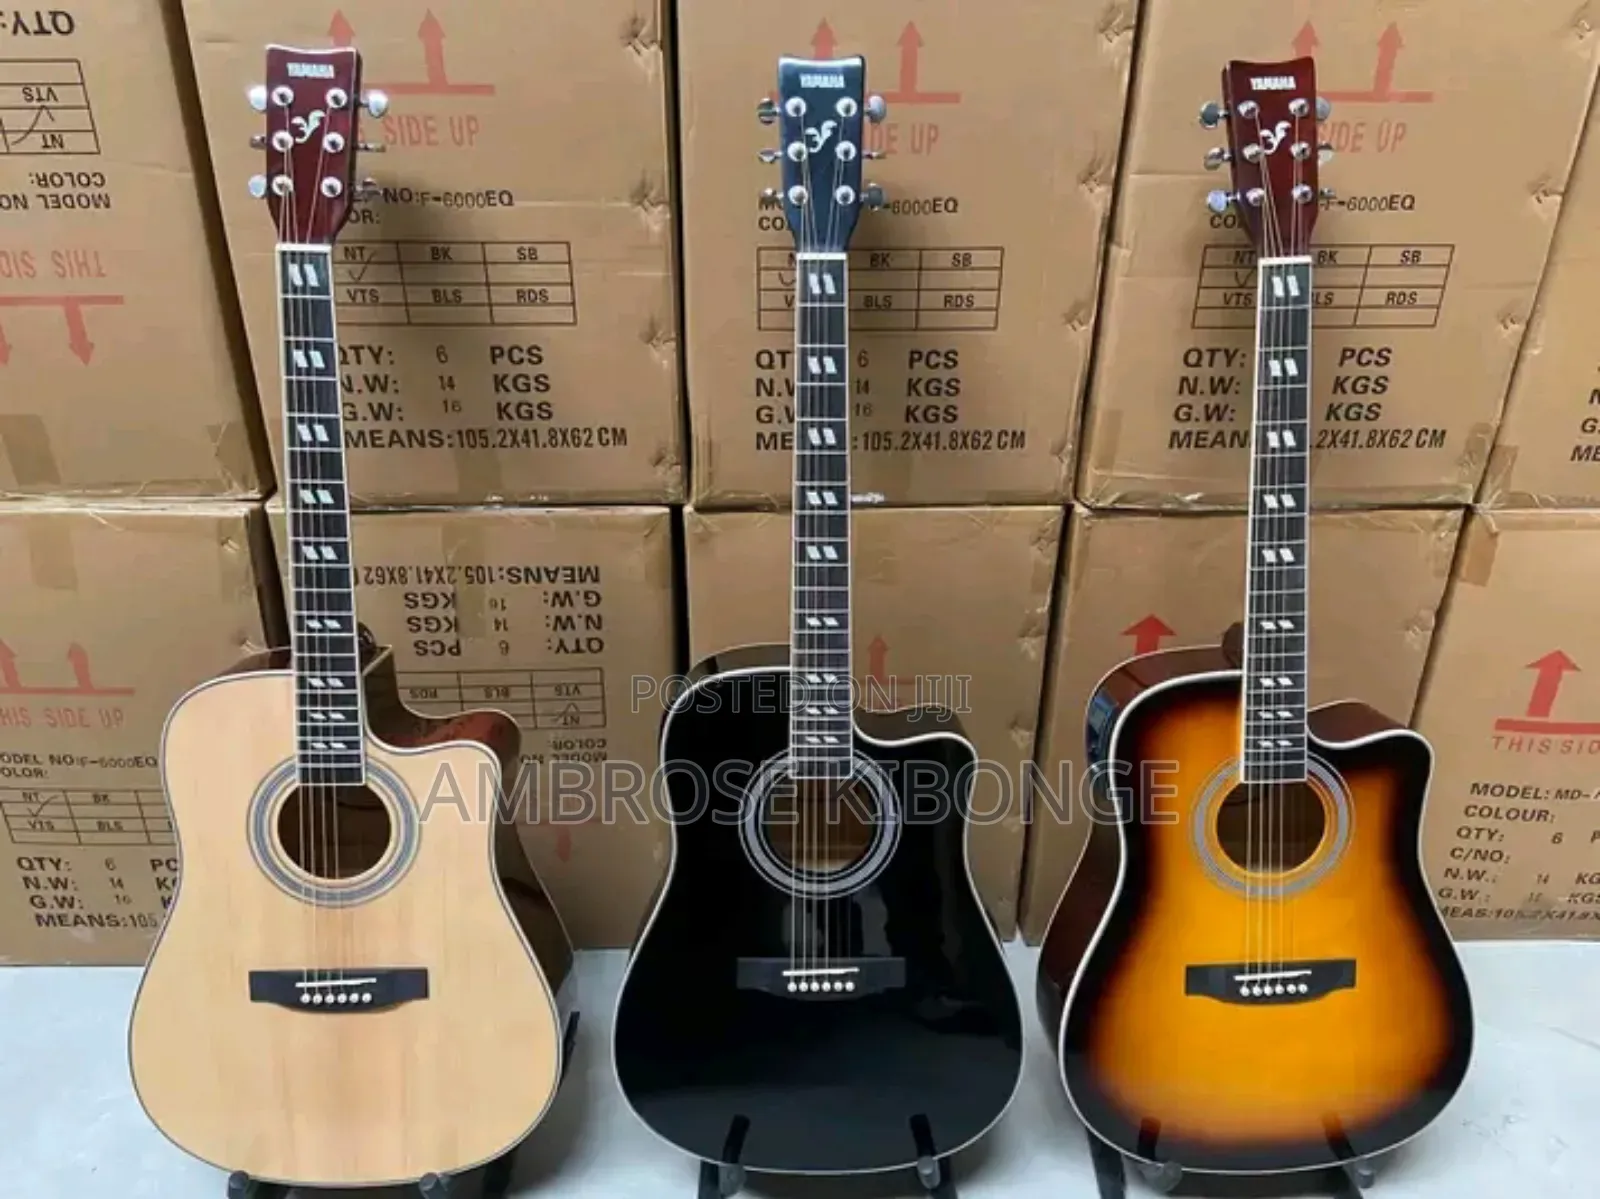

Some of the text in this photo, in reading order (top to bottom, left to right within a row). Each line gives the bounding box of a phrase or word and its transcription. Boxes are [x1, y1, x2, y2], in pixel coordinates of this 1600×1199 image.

[286, 62, 335, 79] YAMAHA
[800, 73, 845, 89] YAMAHA
[1250, 75, 1296, 91] YAMAHA
[21, 86, 59, 103] VTS
[382, 115, 439, 147] SIDE
[449, 115, 481, 147] UP
[910, 123, 940, 156] UP
[1376, 119, 1406, 154] UP
[41, 133, 64, 149] NT
[28, 171, 106, 189] COLOR:
[36, 192, 111, 210] MODEL
[343, 246, 539, 262] NT BK SB
[869, 252, 972, 268] BK SB
[1400, 249, 1420, 265] SB
[51, 249, 107, 279] THIS
[346, 289, 549, 303] VTS BLS RDS
[863, 295, 975, 308] BLS RDS
[1223, 291, 1418, 306] VTS LS RDS
[436, 344, 449, 364] 6
[489, 345, 543, 366] PCS
[857, 349, 870, 369] 6
[908, 349, 959, 370] PCS
[1182, 346, 1393, 369] QTY: PCS
[438, 375, 456, 391] 14
[493, 373, 551, 393] KGS
[855, 378, 870, 395] 14
[907, 378, 961, 398] KGS
[1177, 375, 1390, 396] N.W: KGS
[443, 398, 463, 415] 16
[497, 401, 554, 422] KGS
[905, 404, 960, 425] KGS
[1172, 402, 1383, 424] G.W: KGS
[597, 426, 628, 448] CM
[997, 430, 1026, 450] CM
[1415, 427, 1447, 449] CM
[403, 591, 456, 610] KGS
[543, 589, 602, 609] G.W:
[407, 615, 459, 633] KGS
[545, 614, 603, 632] N.W:
[413, 637, 605, 657] QTY: 6 PCS
[43, 707, 91, 728] SIDE
[98, 708, 124, 729] UP
[1492, 735, 1600, 755] THIS SID
[0, 752, 43, 766] ODEL
[0, 766, 49, 779] OLOR:
[1469, 782, 1550, 800] MODEL:
[1463, 804, 1556, 824] COLOUR:
[1456, 826, 1564, 845] QTY: 6
[16, 856, 178, 873] QTY: 6 PC
[1449, 847, 1511, 865] C/NO:
[22, 875, 78, 891] N.W:
[1575, 872, 1600, 885] KG
[29, 894, 84, 911] G.W:
